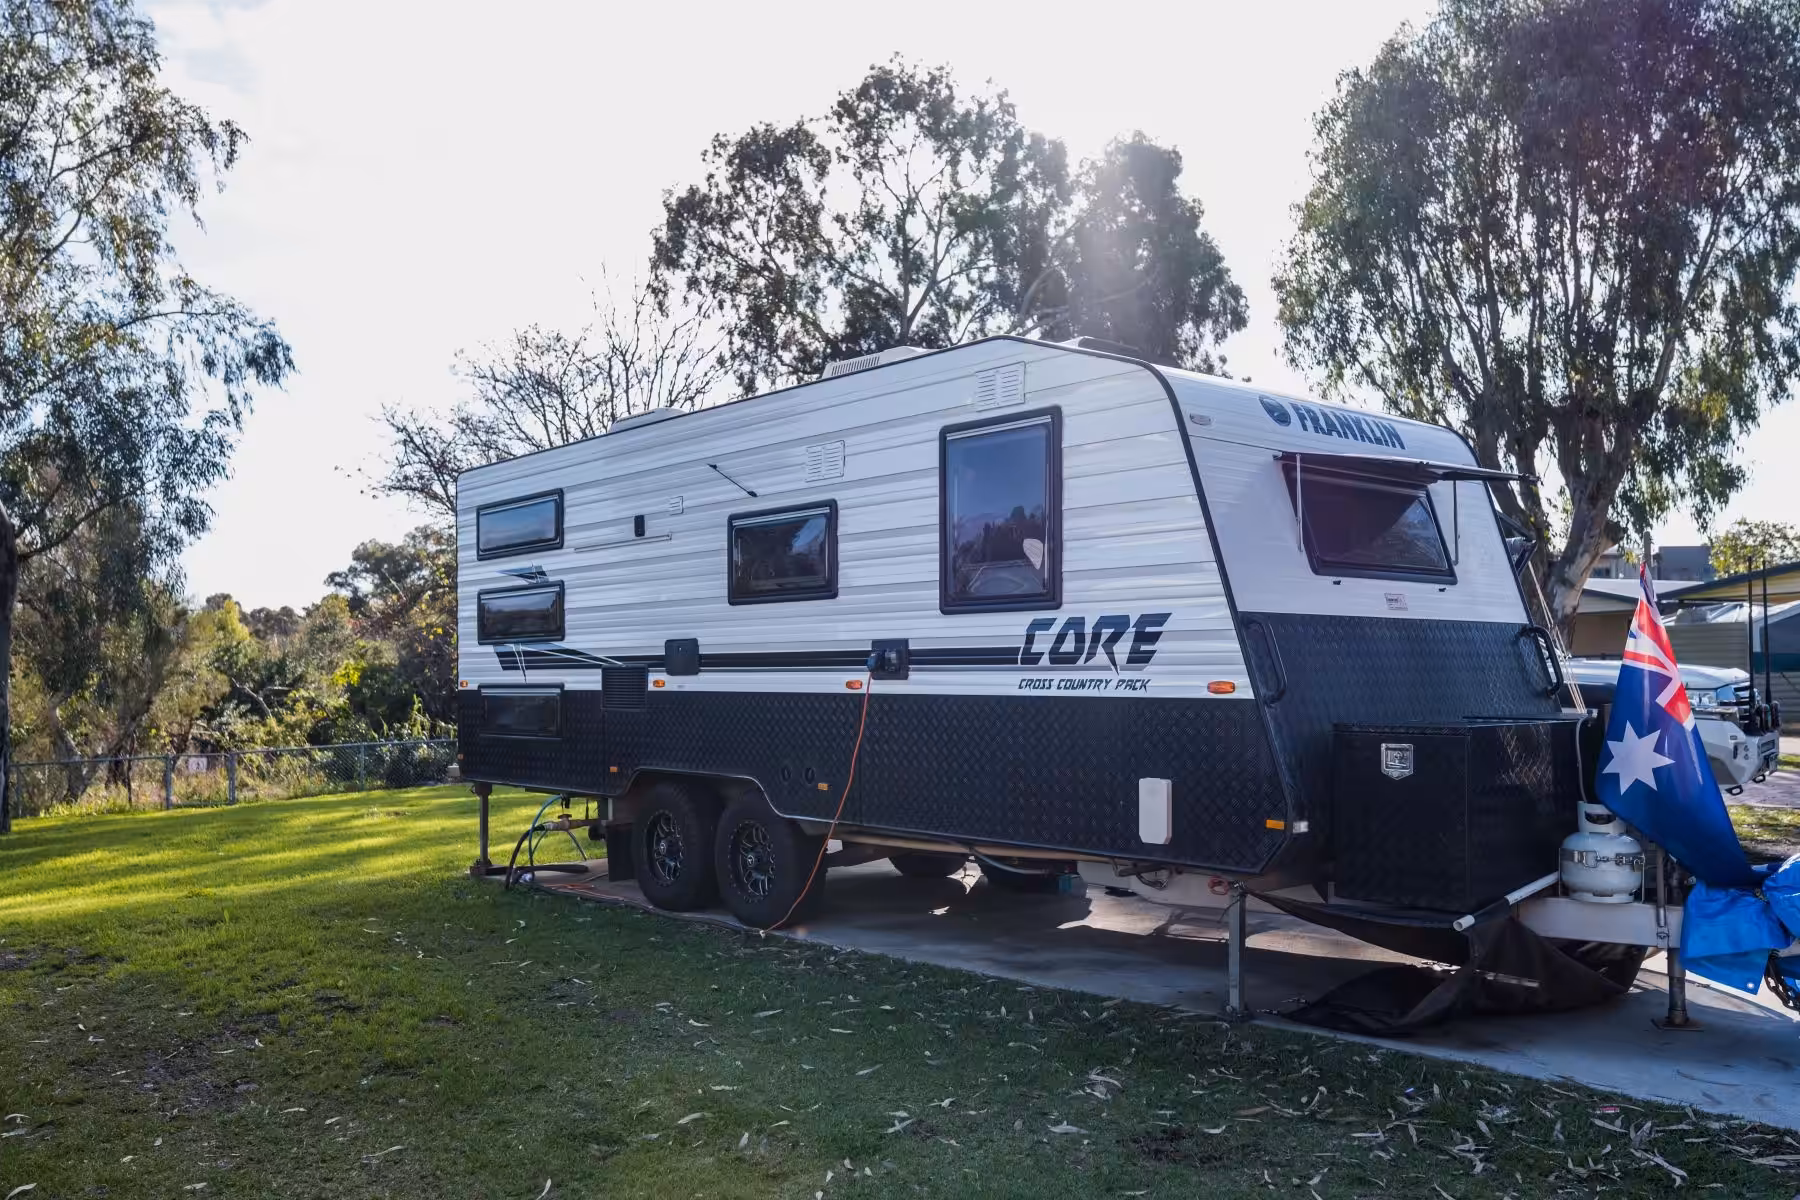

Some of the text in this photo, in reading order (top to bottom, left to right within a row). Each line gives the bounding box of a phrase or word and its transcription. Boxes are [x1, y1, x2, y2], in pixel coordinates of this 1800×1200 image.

[1289, 402, 1406, 450] FRANKLIN
[1020, 612, 1173, 676] CORE
[1018, 678, 1152, 693] CROSS COUNTRY PACK
